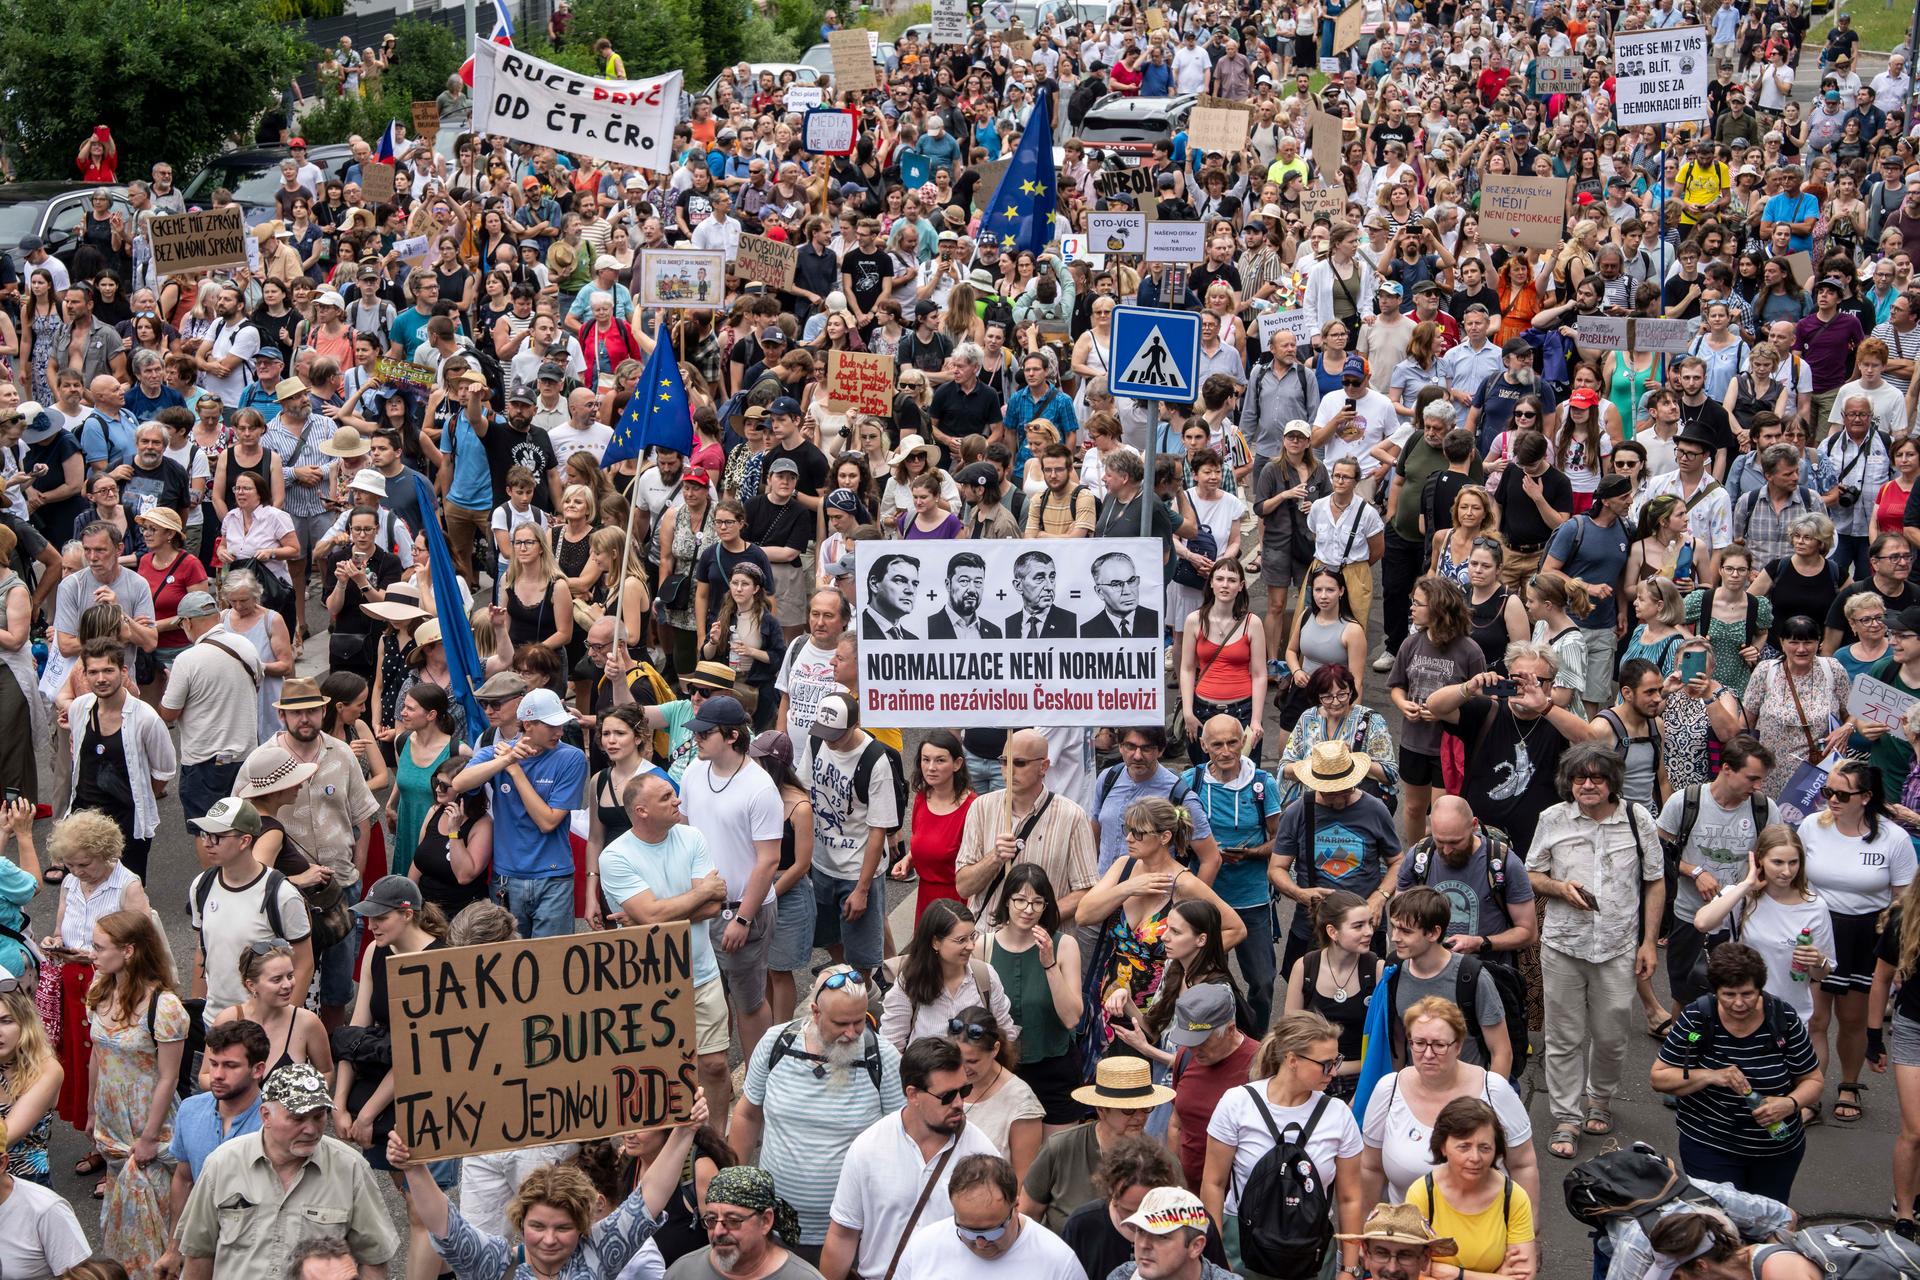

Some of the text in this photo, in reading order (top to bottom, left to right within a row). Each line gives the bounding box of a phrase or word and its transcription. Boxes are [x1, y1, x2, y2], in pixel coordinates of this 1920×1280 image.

[1620, 36, 1701, 57] CHCE SE MI Z VÁS
[1649, 58, 1671, 73] BLÍT,
[502, 54, 661, 106] RUCE PRYČ
[1640, 79, 1684, 94] JDU SE ZA
[1623, 94, 1701, 114] DEMOKRACII BÍT!
[495, 93, 530, 120] OD
[546, 102, 587, 134] ČT
[586, 130, 598, 139] a
[1310, 189, 1327, 198] OTO
[1485, 185, 1499, 193] BEZ
[188, 212, 205, 232] MÍT
[206, 209, 240, 231] ZPRÁVY
[1093, 218, 1140, 228] OTO-VÍCE
[1484, 209, 1562, 224] NENÍ DEMOKRACIE
[154, 243, 174, 262] BEZ
[174, 233, 207, 259] VLÁDNÍ
[208, 231, 244, 256] SPRÁVY
[1264, 314, 1304, 327] Nechceme
[1291, 323, 1302, 332] ČT
[867, 647, 1157, 681] NORMALIZACE NENÍ NORMÁLNÍ
[868, 683, 1157, 711] Braňme nezávislou Českou televizi
[840, 839, 858, 850] AZ.
[1316, 835, 1357, 844] MARMOT
[398, 925, 691, 1019] JAKO ORBÁN
[522, 988, 685, 1068] BUREŠ,
[1144, 1206, 1207, 1228] MÜNCHE
